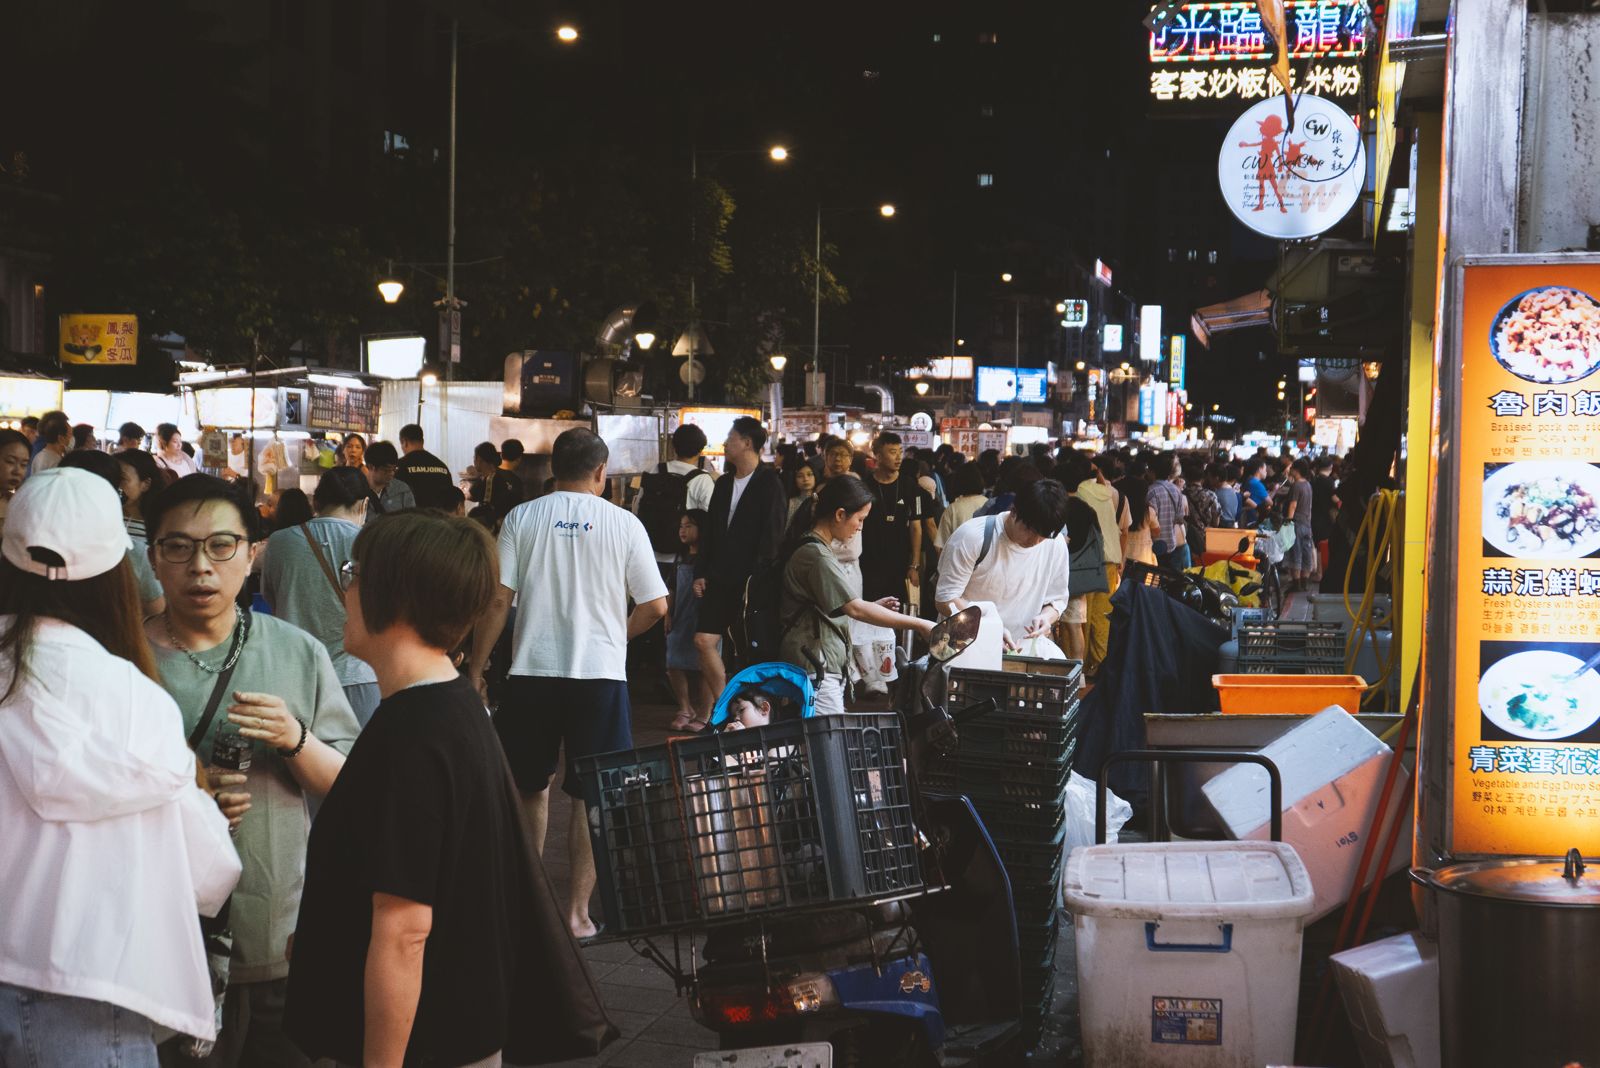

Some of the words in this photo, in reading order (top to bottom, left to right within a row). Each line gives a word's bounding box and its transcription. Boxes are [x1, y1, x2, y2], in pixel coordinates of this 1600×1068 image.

[1305, 119, 1329, 135] CW
[1242, 154, 1268, 170] CW
[1488, 389, 1600, 417] 魯肉飯
[1491, 423, 1532, 431] Braised
[1538, 424, 1562, 432] pork
[1482, 567, 1600, 597] 蒜泥鮮蚵
[1483, 599, 1511, 608] Fresh
[1514, 599, 1551, 609] Oysters
[1555, 600, 1573, 608] with
[1472, 779, 1520, 789] Vegetable
[1543, 781, 1560, 791] Egg
[1564, 781, 1586, 791] Drop
